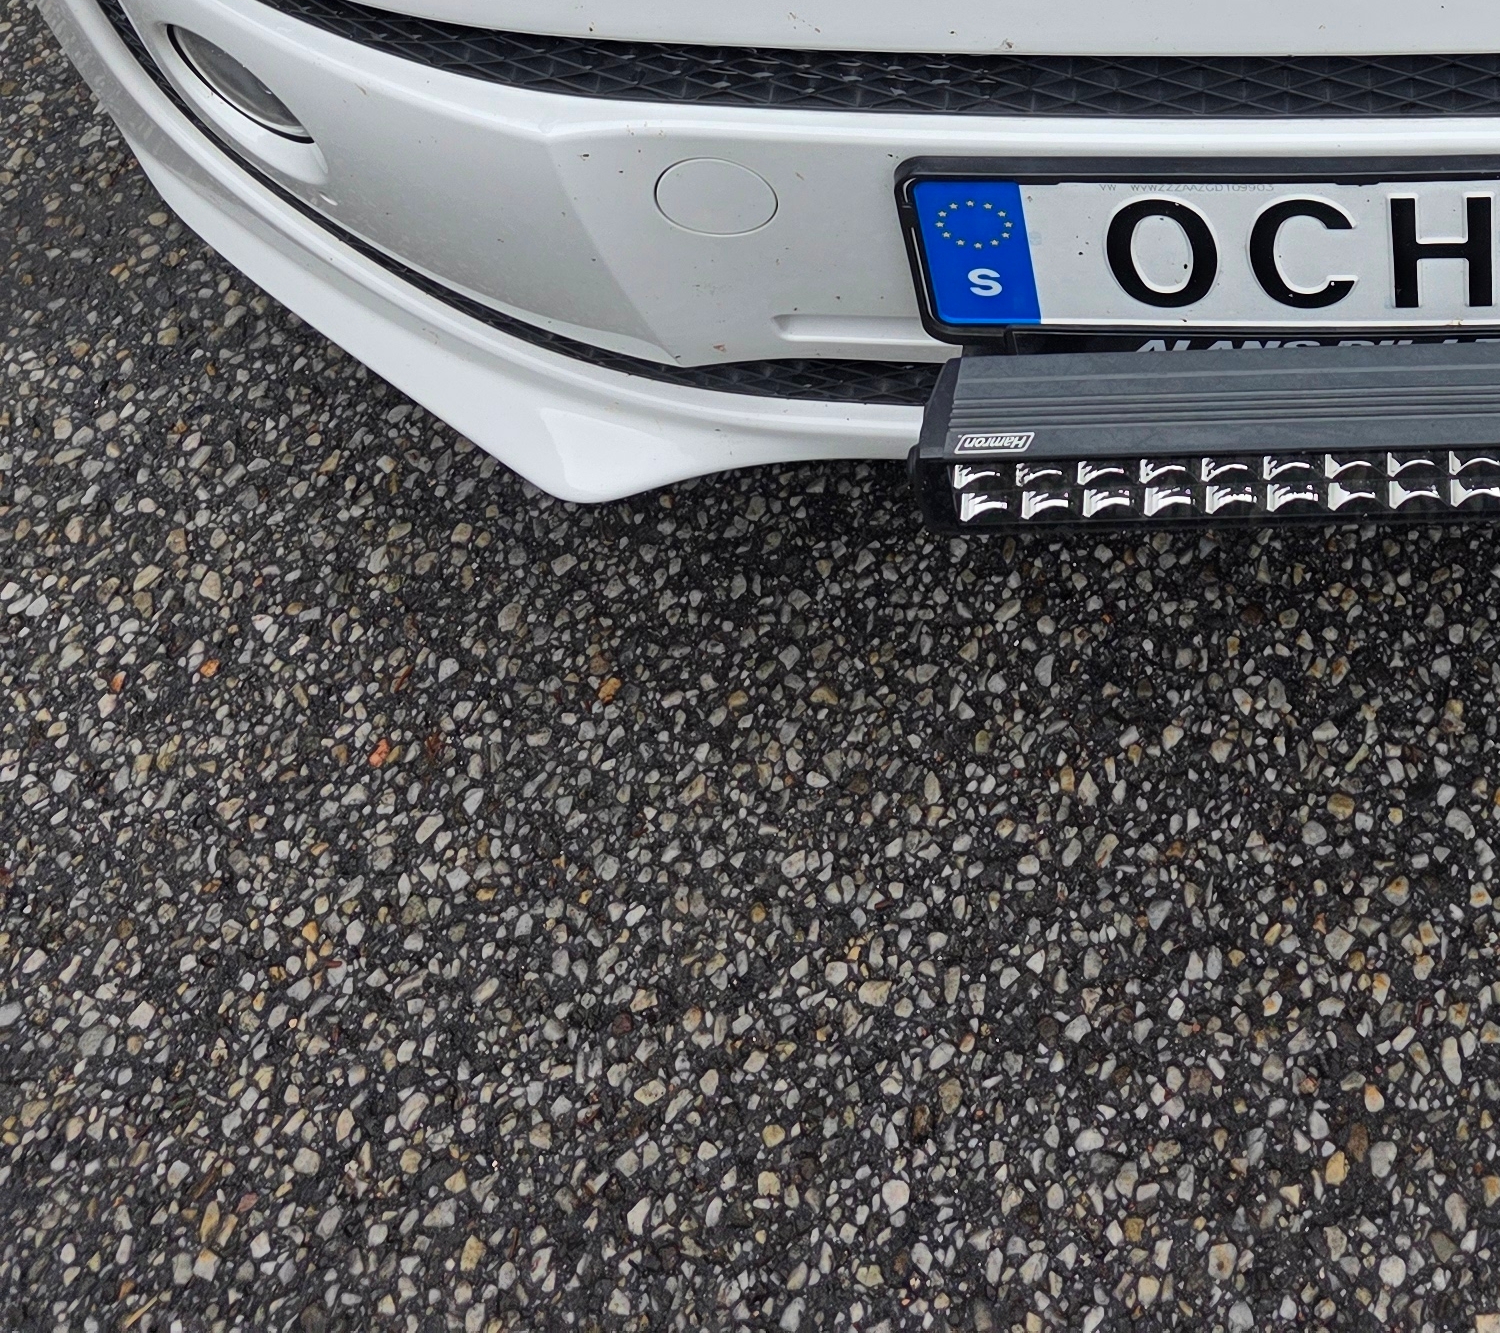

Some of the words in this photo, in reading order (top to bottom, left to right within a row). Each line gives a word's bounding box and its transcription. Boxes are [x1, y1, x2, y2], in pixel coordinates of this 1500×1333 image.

[1099, 183, 1117, 192] VW
[1105, 195, 1494, 310] OCH
[967, 267, 1003, 297] S
[963, 435, 1027, 449] Hamron
